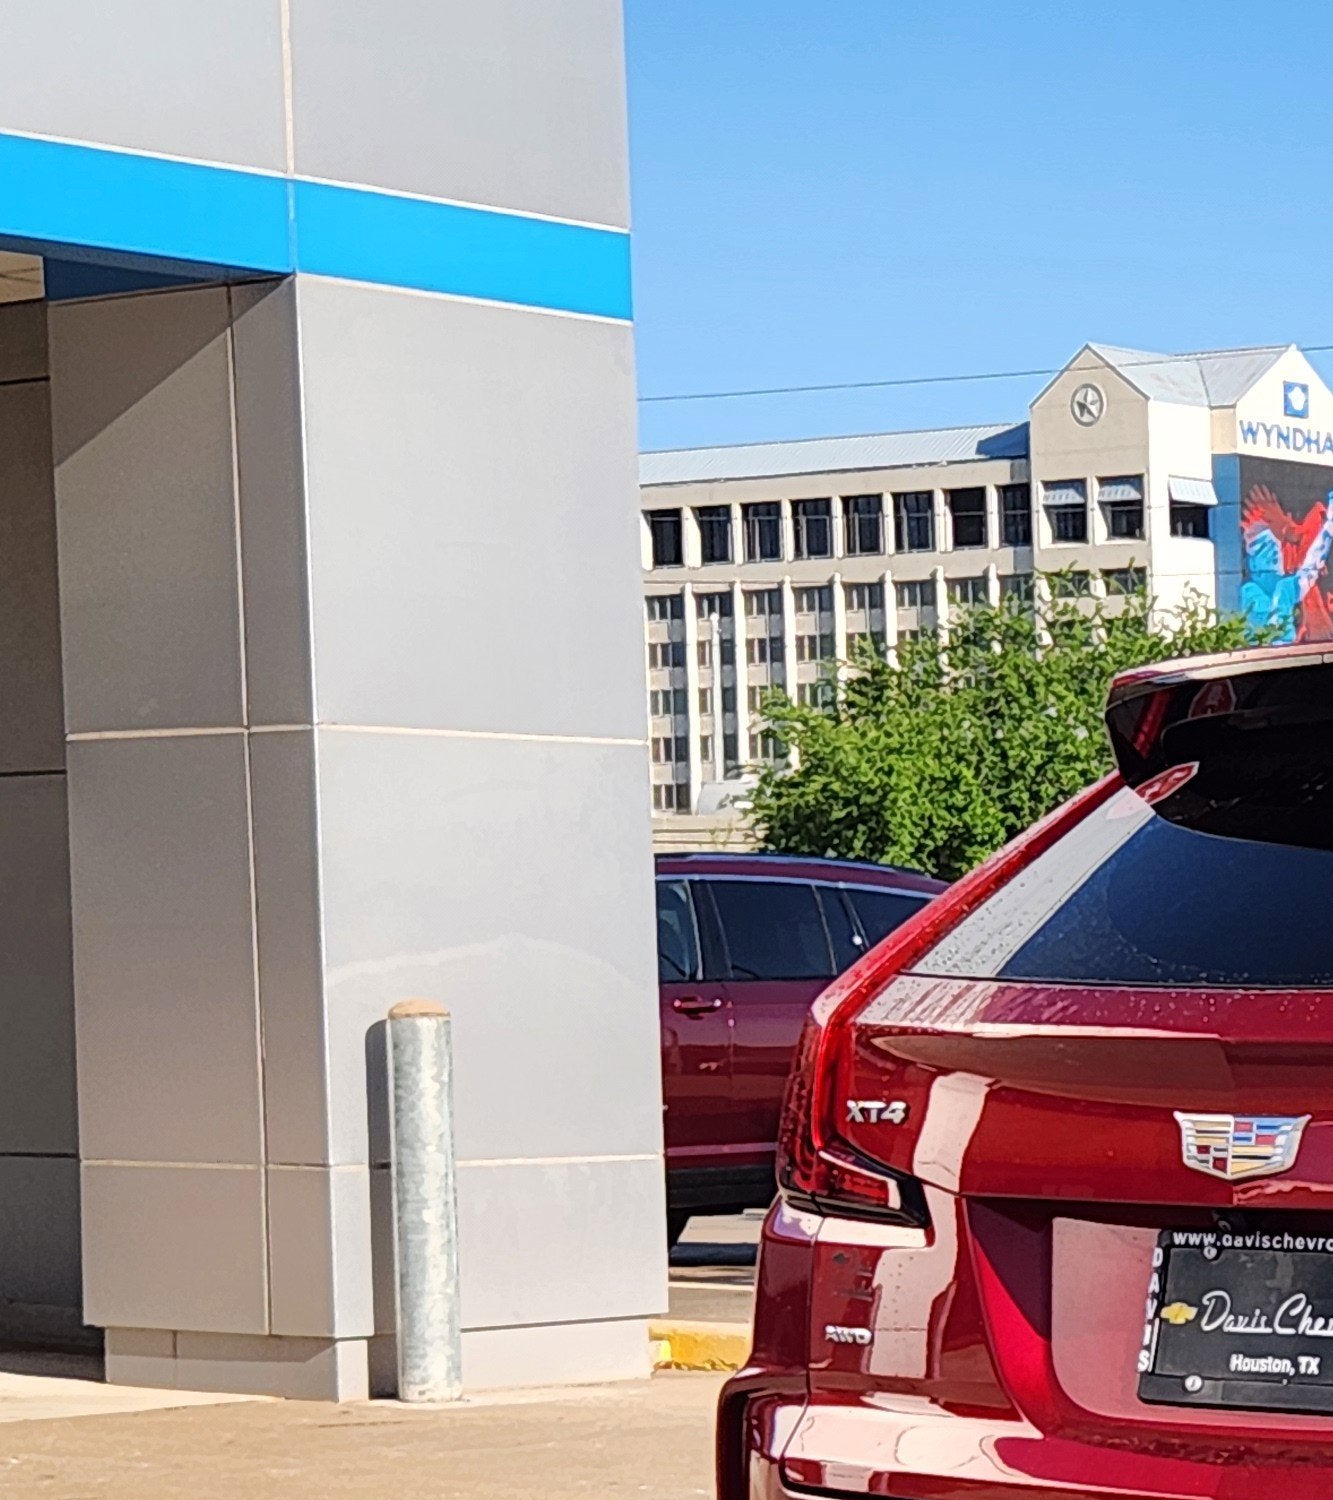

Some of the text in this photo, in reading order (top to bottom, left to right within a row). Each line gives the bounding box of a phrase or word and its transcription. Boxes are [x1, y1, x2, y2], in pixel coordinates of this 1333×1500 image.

[845, 1099, 907, 1125] XT4
[1137, 1246, 1164, 1373] DAVIS
[1200, 1290, 1273, 1333] Davis
[1229, 1353, 1321, 1376] Houston, TX
